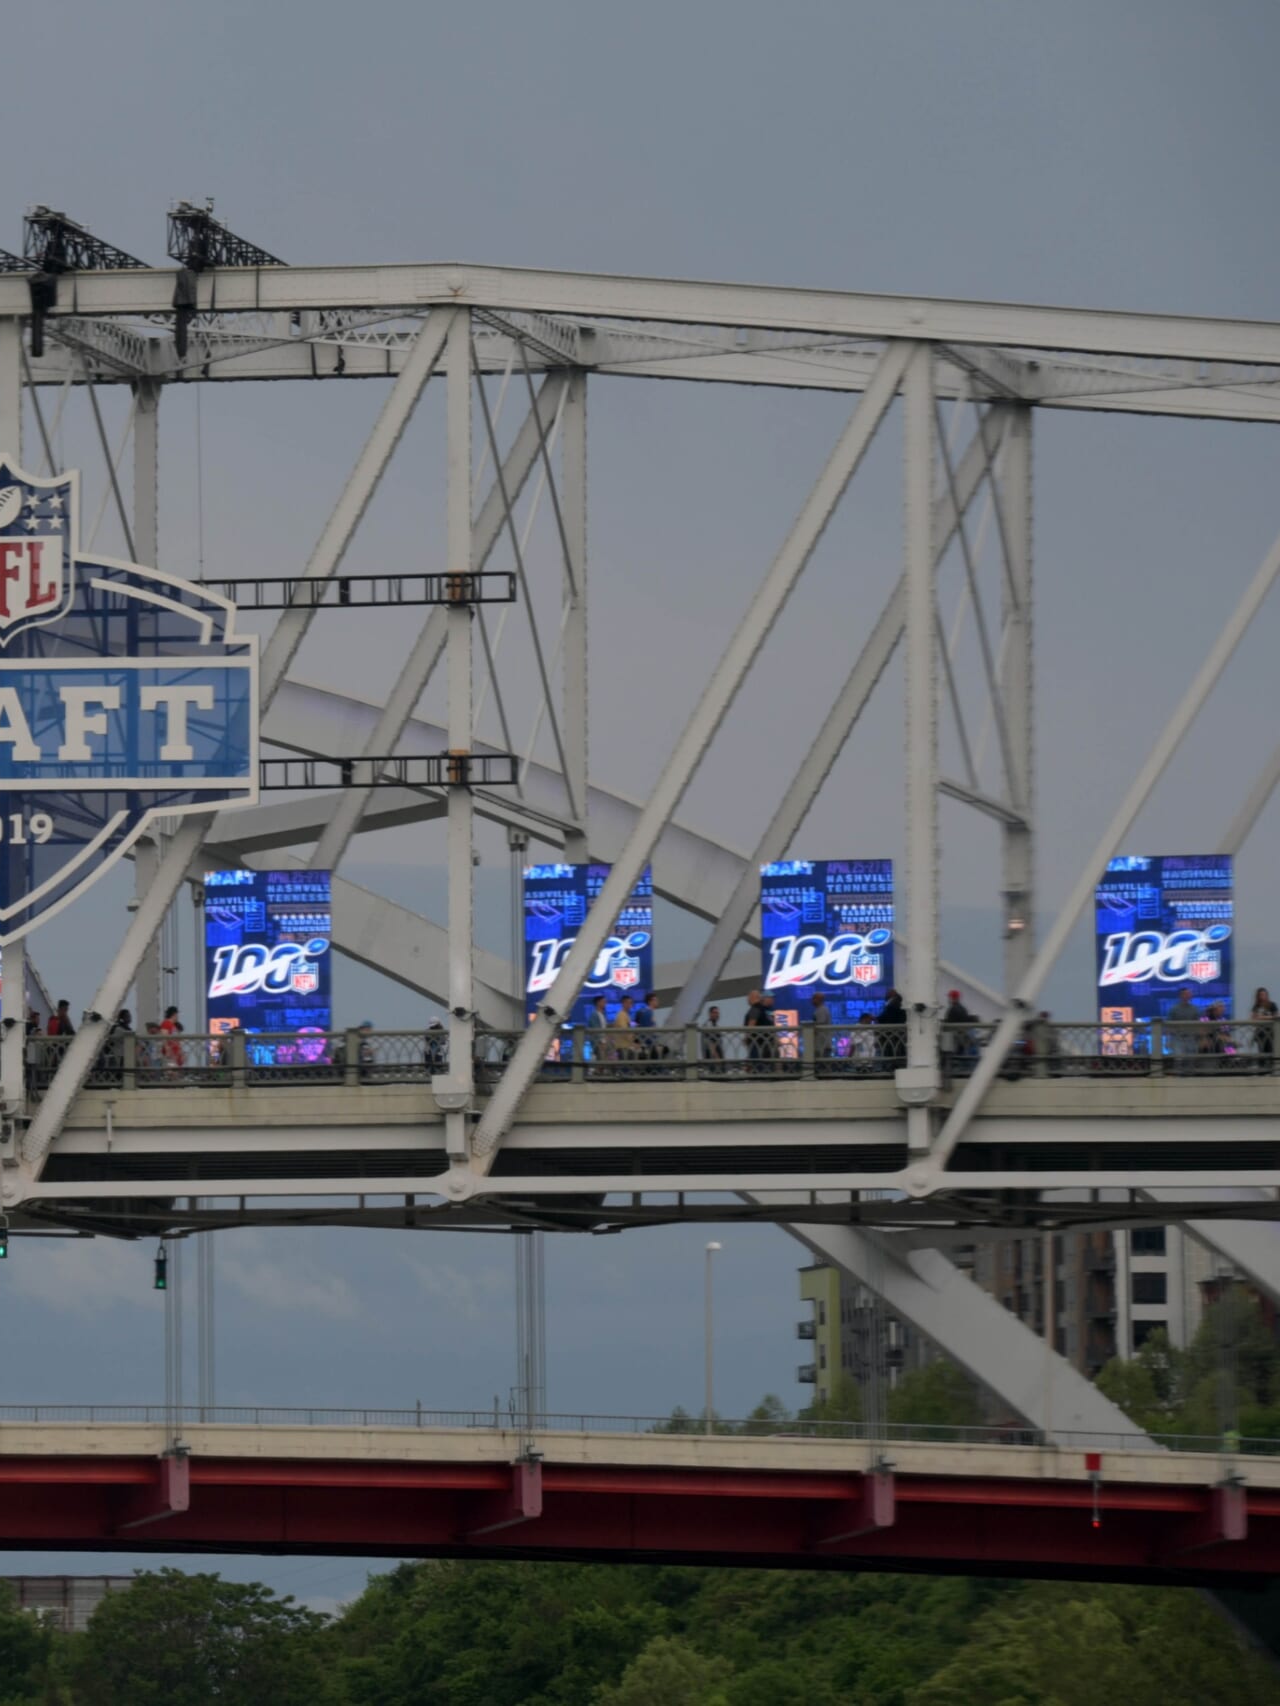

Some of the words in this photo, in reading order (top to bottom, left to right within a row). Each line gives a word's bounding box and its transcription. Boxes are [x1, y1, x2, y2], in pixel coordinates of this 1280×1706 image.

[208, 943, 303, 998] 100
[765, 934, 863, 990] 100
[854, 966, 878, 981] NFL
[1099, 931, 1199, 986] 100
[1190, 962, 1217, 977] NFL
[294, 975, 314, 990] NFL
